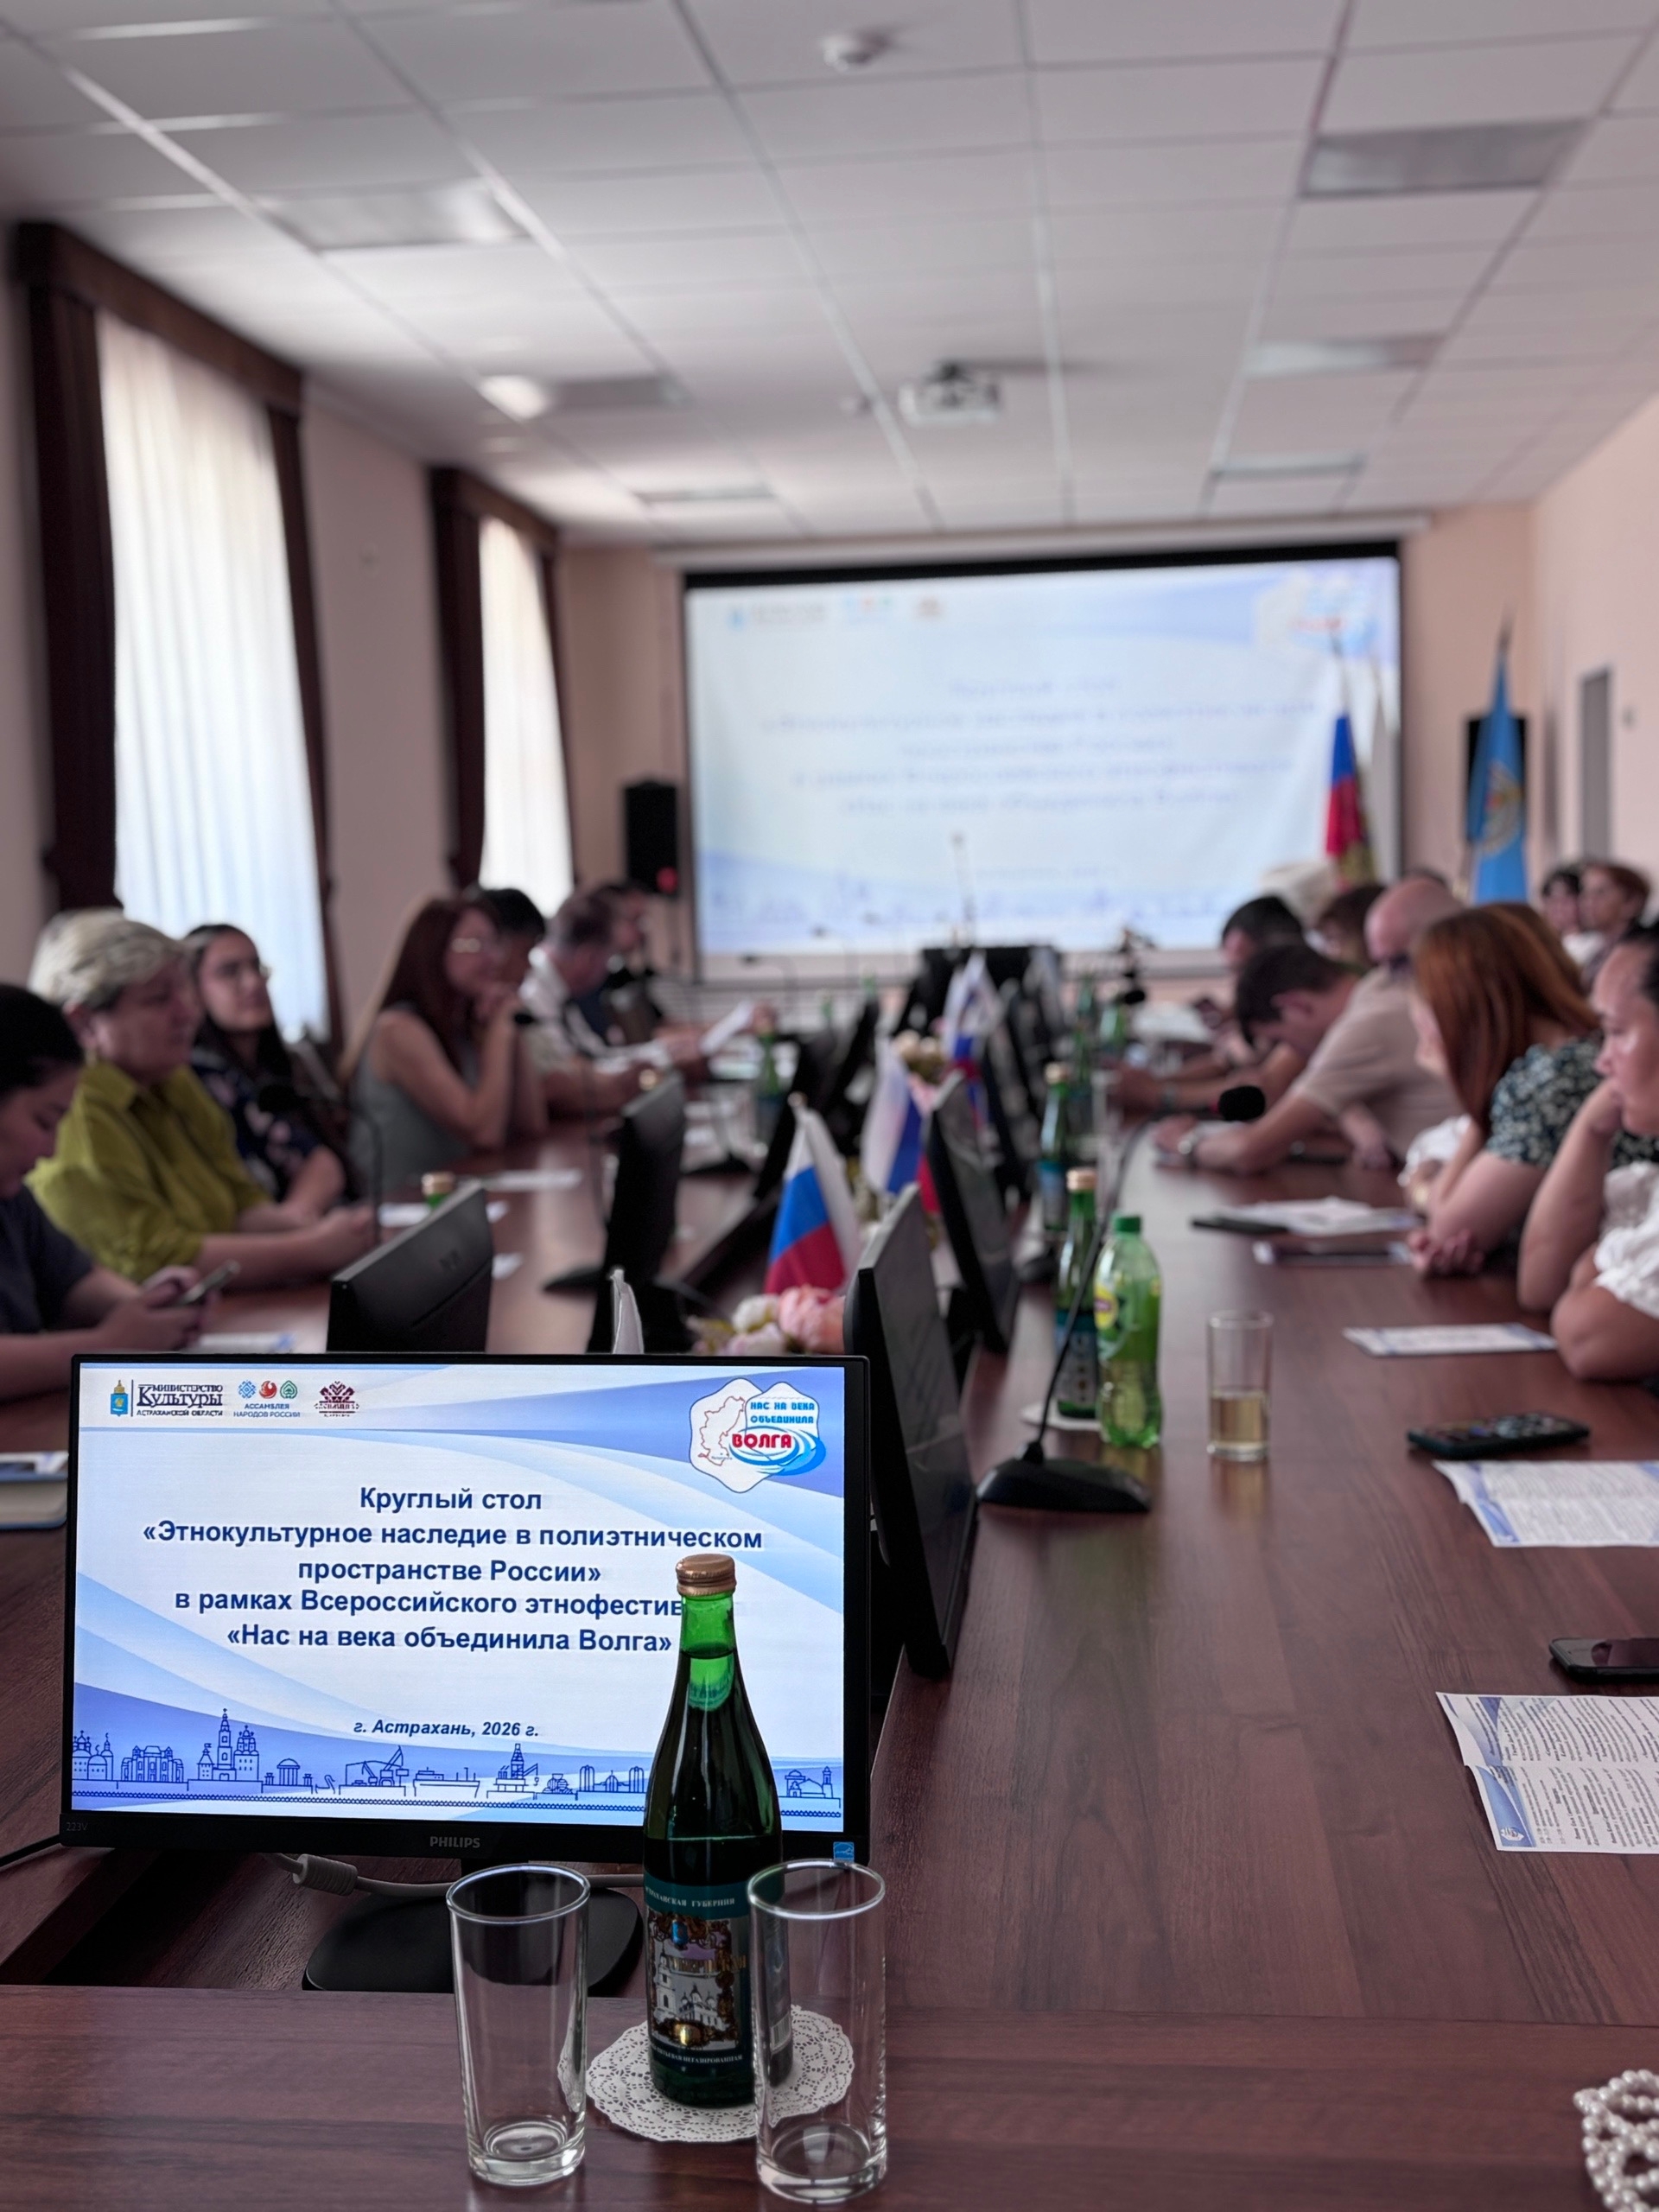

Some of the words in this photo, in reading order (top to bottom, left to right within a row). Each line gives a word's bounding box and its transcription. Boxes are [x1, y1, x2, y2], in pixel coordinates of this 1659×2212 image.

[137, 1384, 223, 1408] Культуры
[750, 1402, 770, 1410] НАС
[732, 1433, 791, 1449] ВОЛГА
[360, 1487, 473, 1514] Круглый
[482, 1493, 542, 1510] стол
[143, 1520, 372, 1548] «Этнокультурное
[381, 1526, 507, 1548] наследие
[516, 1529, 531, 1545] в
[539, 1529, 762, 1548] полиэтническом
[298, 1562, 482, 1585] пространстве
[490, 1560, 601, 1582] России»
[175, 1592, 190, 1609] в
[199, 1593, 292, 1614] рамках
[302, 1589, 517, 1617] Всероссийского
[524, 1594, 682, 1620] этнофестив
[227, 1624, 290, 1645] «Нас
[299, 1630, 328, 1646] на
[338, 1630, 396, 1647] века
[404, 1626, 569, 1652] объединила
[579, 1629, 672, 1652] Волга»
[353, 1722, 366, 1733] г.
[372, 1719, 476, 1738] Астрахань,
[481, 1721, 521, 1737] 2026
[525, 1726, 539, 1737] г.
[429, 1836, 481, 1848] PHILIPS
